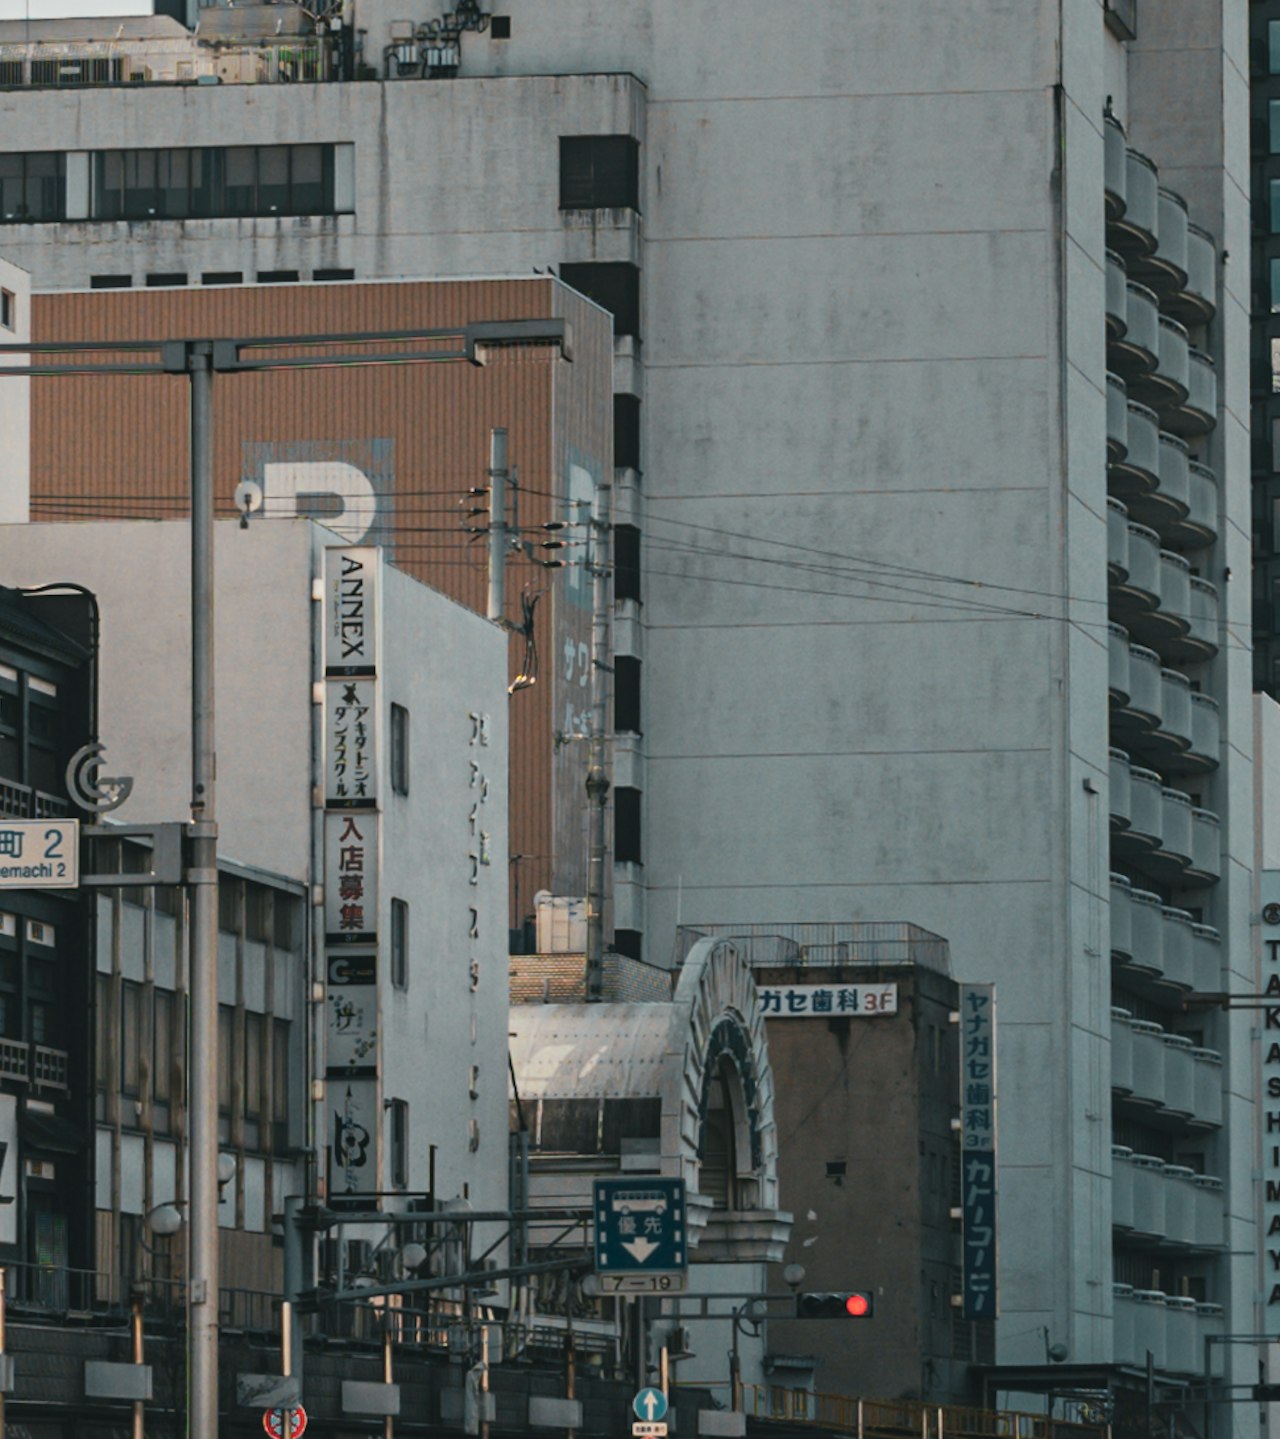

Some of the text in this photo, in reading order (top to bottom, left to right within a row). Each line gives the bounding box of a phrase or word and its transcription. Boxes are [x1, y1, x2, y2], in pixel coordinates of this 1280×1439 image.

[341, 556, 364, 658] ANNEX
[44, 828, 64, 859] 2
[57, 862, 66, 878] 2
[338, 816, 364, 931] 入店募集
[759, 989, 894, 1013] ガセ歯科 3F
[966, 992, 990, 1132] ヤナガセ歯科
[618, 1215, 663, 1235] 優先
